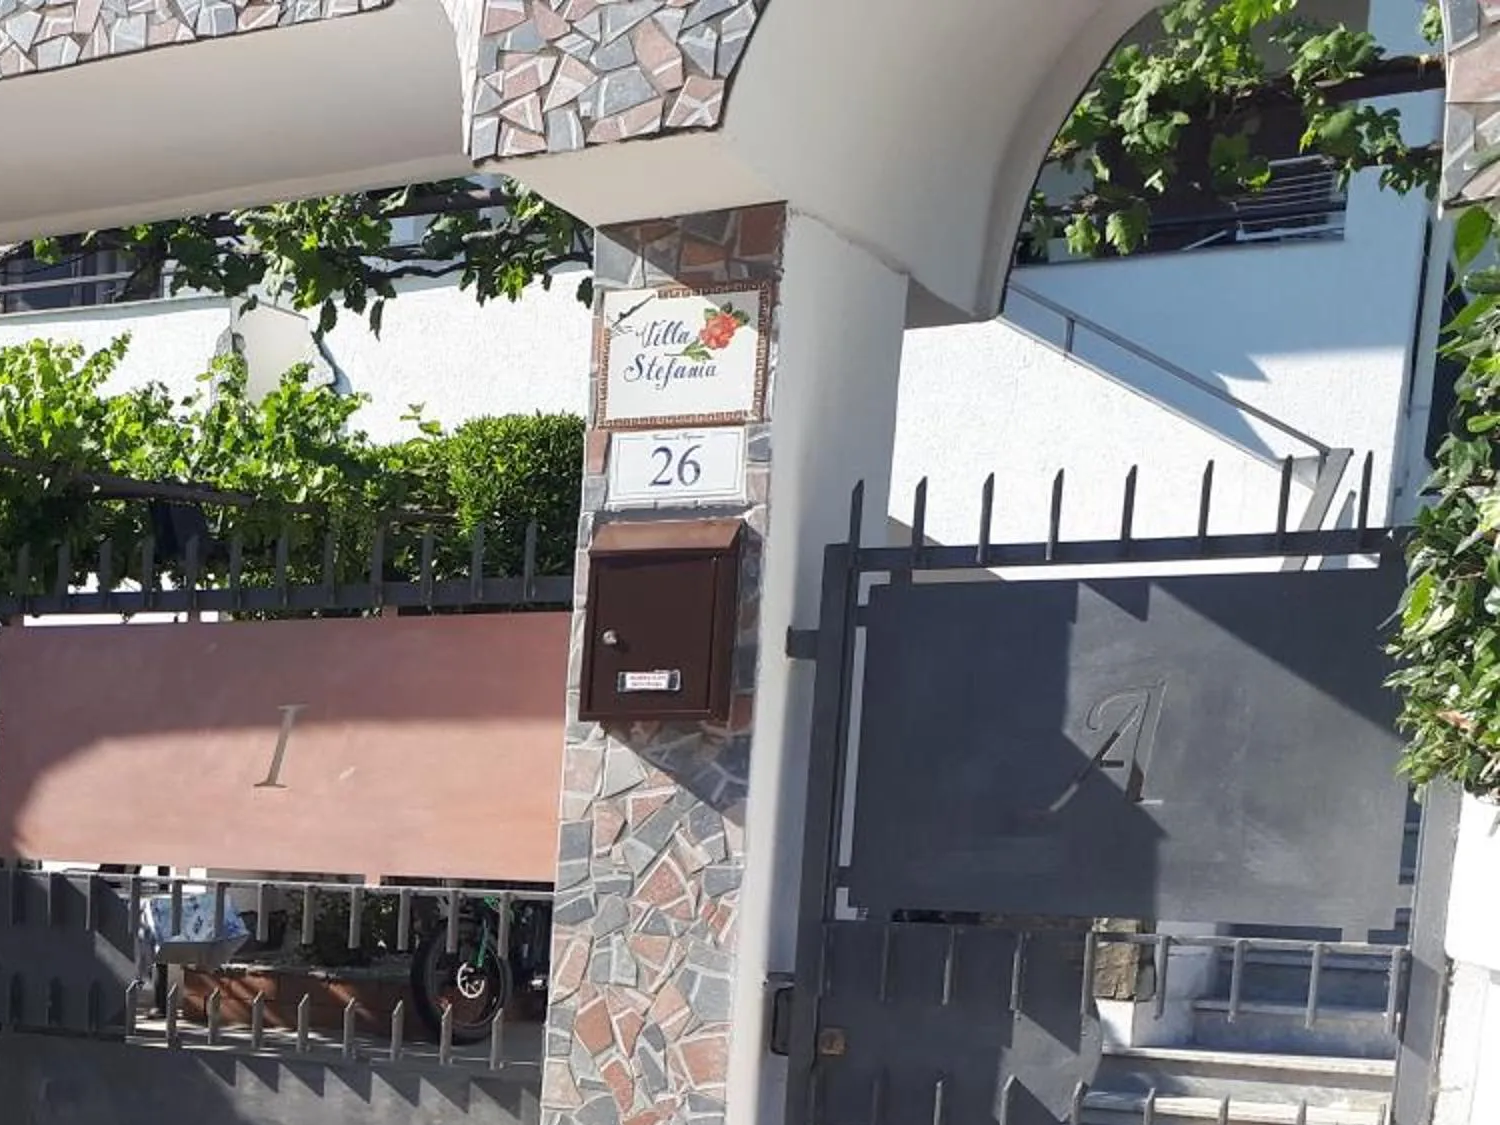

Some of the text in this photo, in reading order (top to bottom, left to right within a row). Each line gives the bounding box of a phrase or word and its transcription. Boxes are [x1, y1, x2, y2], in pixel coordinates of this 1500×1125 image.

[635, 320, 690, 348] Villa
[623, 353, 716, 391] Stefania
[648, 444, 701, 487] 26
[1050, 678, 1167, 812] A
